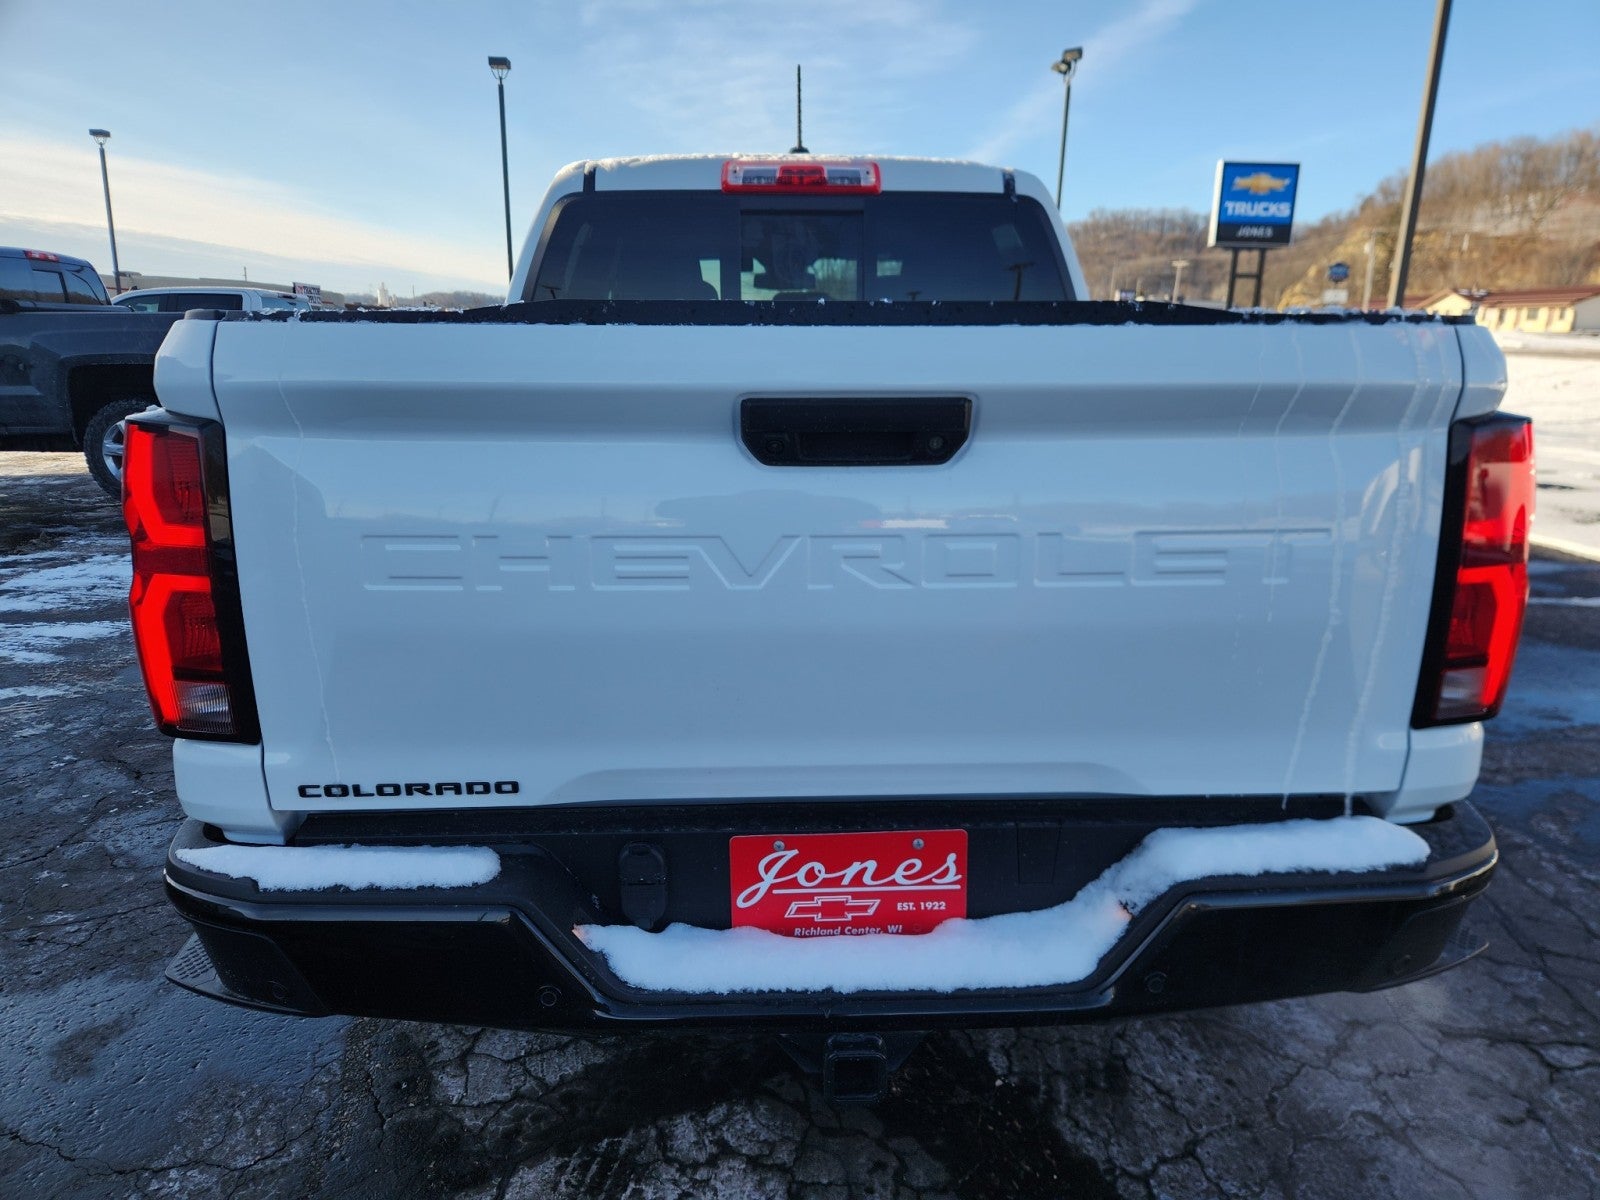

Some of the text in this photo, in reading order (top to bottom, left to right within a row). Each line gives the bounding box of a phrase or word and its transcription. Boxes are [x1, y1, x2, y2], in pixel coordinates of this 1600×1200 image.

[1224, 200, 1291, 218] TRUCKS
[1236, 225, 1273, 238] JONES
[361, 528, 1332, 591] CHEVROLET
[298, 780, 520, 798] COLORADO
[736, 849, 962, 909] Jones
[897, 901, 946, 911] EST. 1922
[794, 927, 841, 937] Richland
[887, 924, 903, 934] WI
